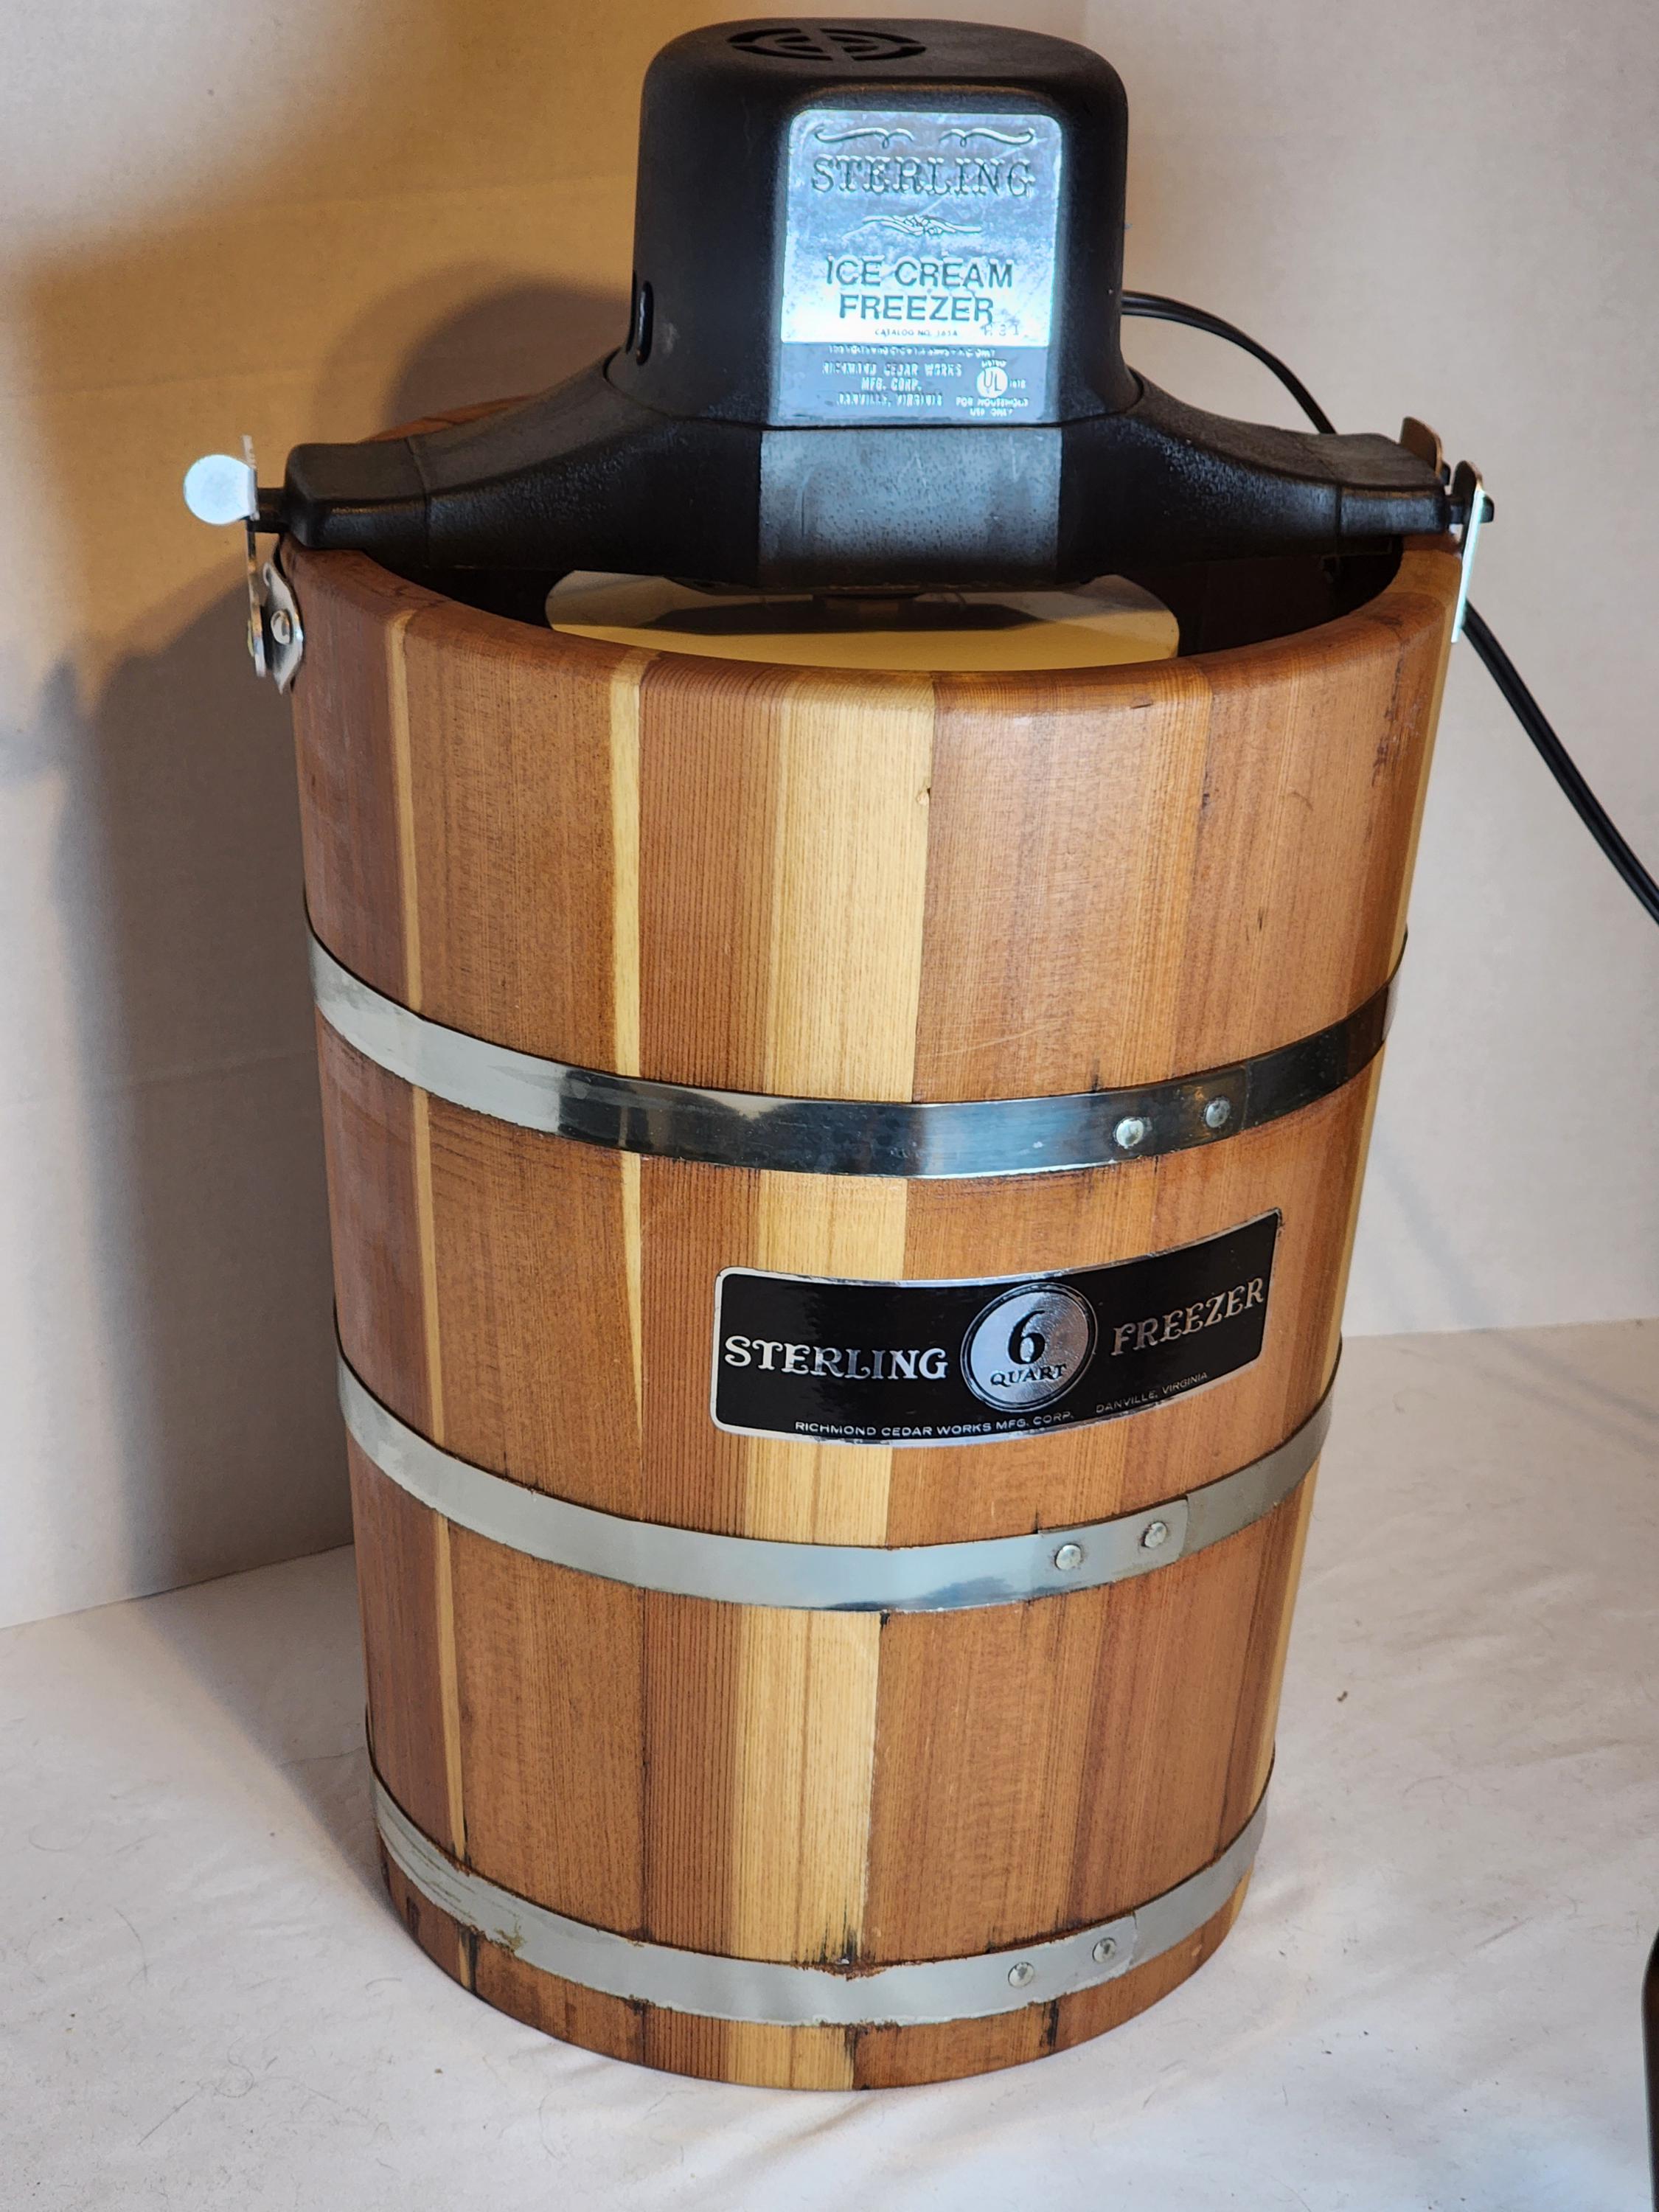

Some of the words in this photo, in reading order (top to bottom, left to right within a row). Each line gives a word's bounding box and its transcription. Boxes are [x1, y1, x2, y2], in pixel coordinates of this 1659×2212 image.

[812, 154, 1035, 198] STERLING
[827, 254, 885, 286] ICE
[894, 256, 1014, 288] CREAM
[839, 293, 994, 324] FREEZER
[925, 363, 962, 378] WORKS
[1008, 1310, 1046, 1365] 6
[1110, 1277, 1265, 1356] FREEZER
[724, 1335, 949, 1380] STERLING
[990, 1363, 1068, 1388] QUART
[795, 1420, 877, 1436] RICHMOND
[880, 1426, 933, 1437] CEDAR
[936, 1422, 992, 1436] WORKS
[995, 1417, 1030, 1430] MFG.
[1032, 1410, 1075, 1426] CORP.
[1096, 1390, 1158, 1413] DANVILLE,
[1162, 1371, 1208, 1394] VIRGINIA
